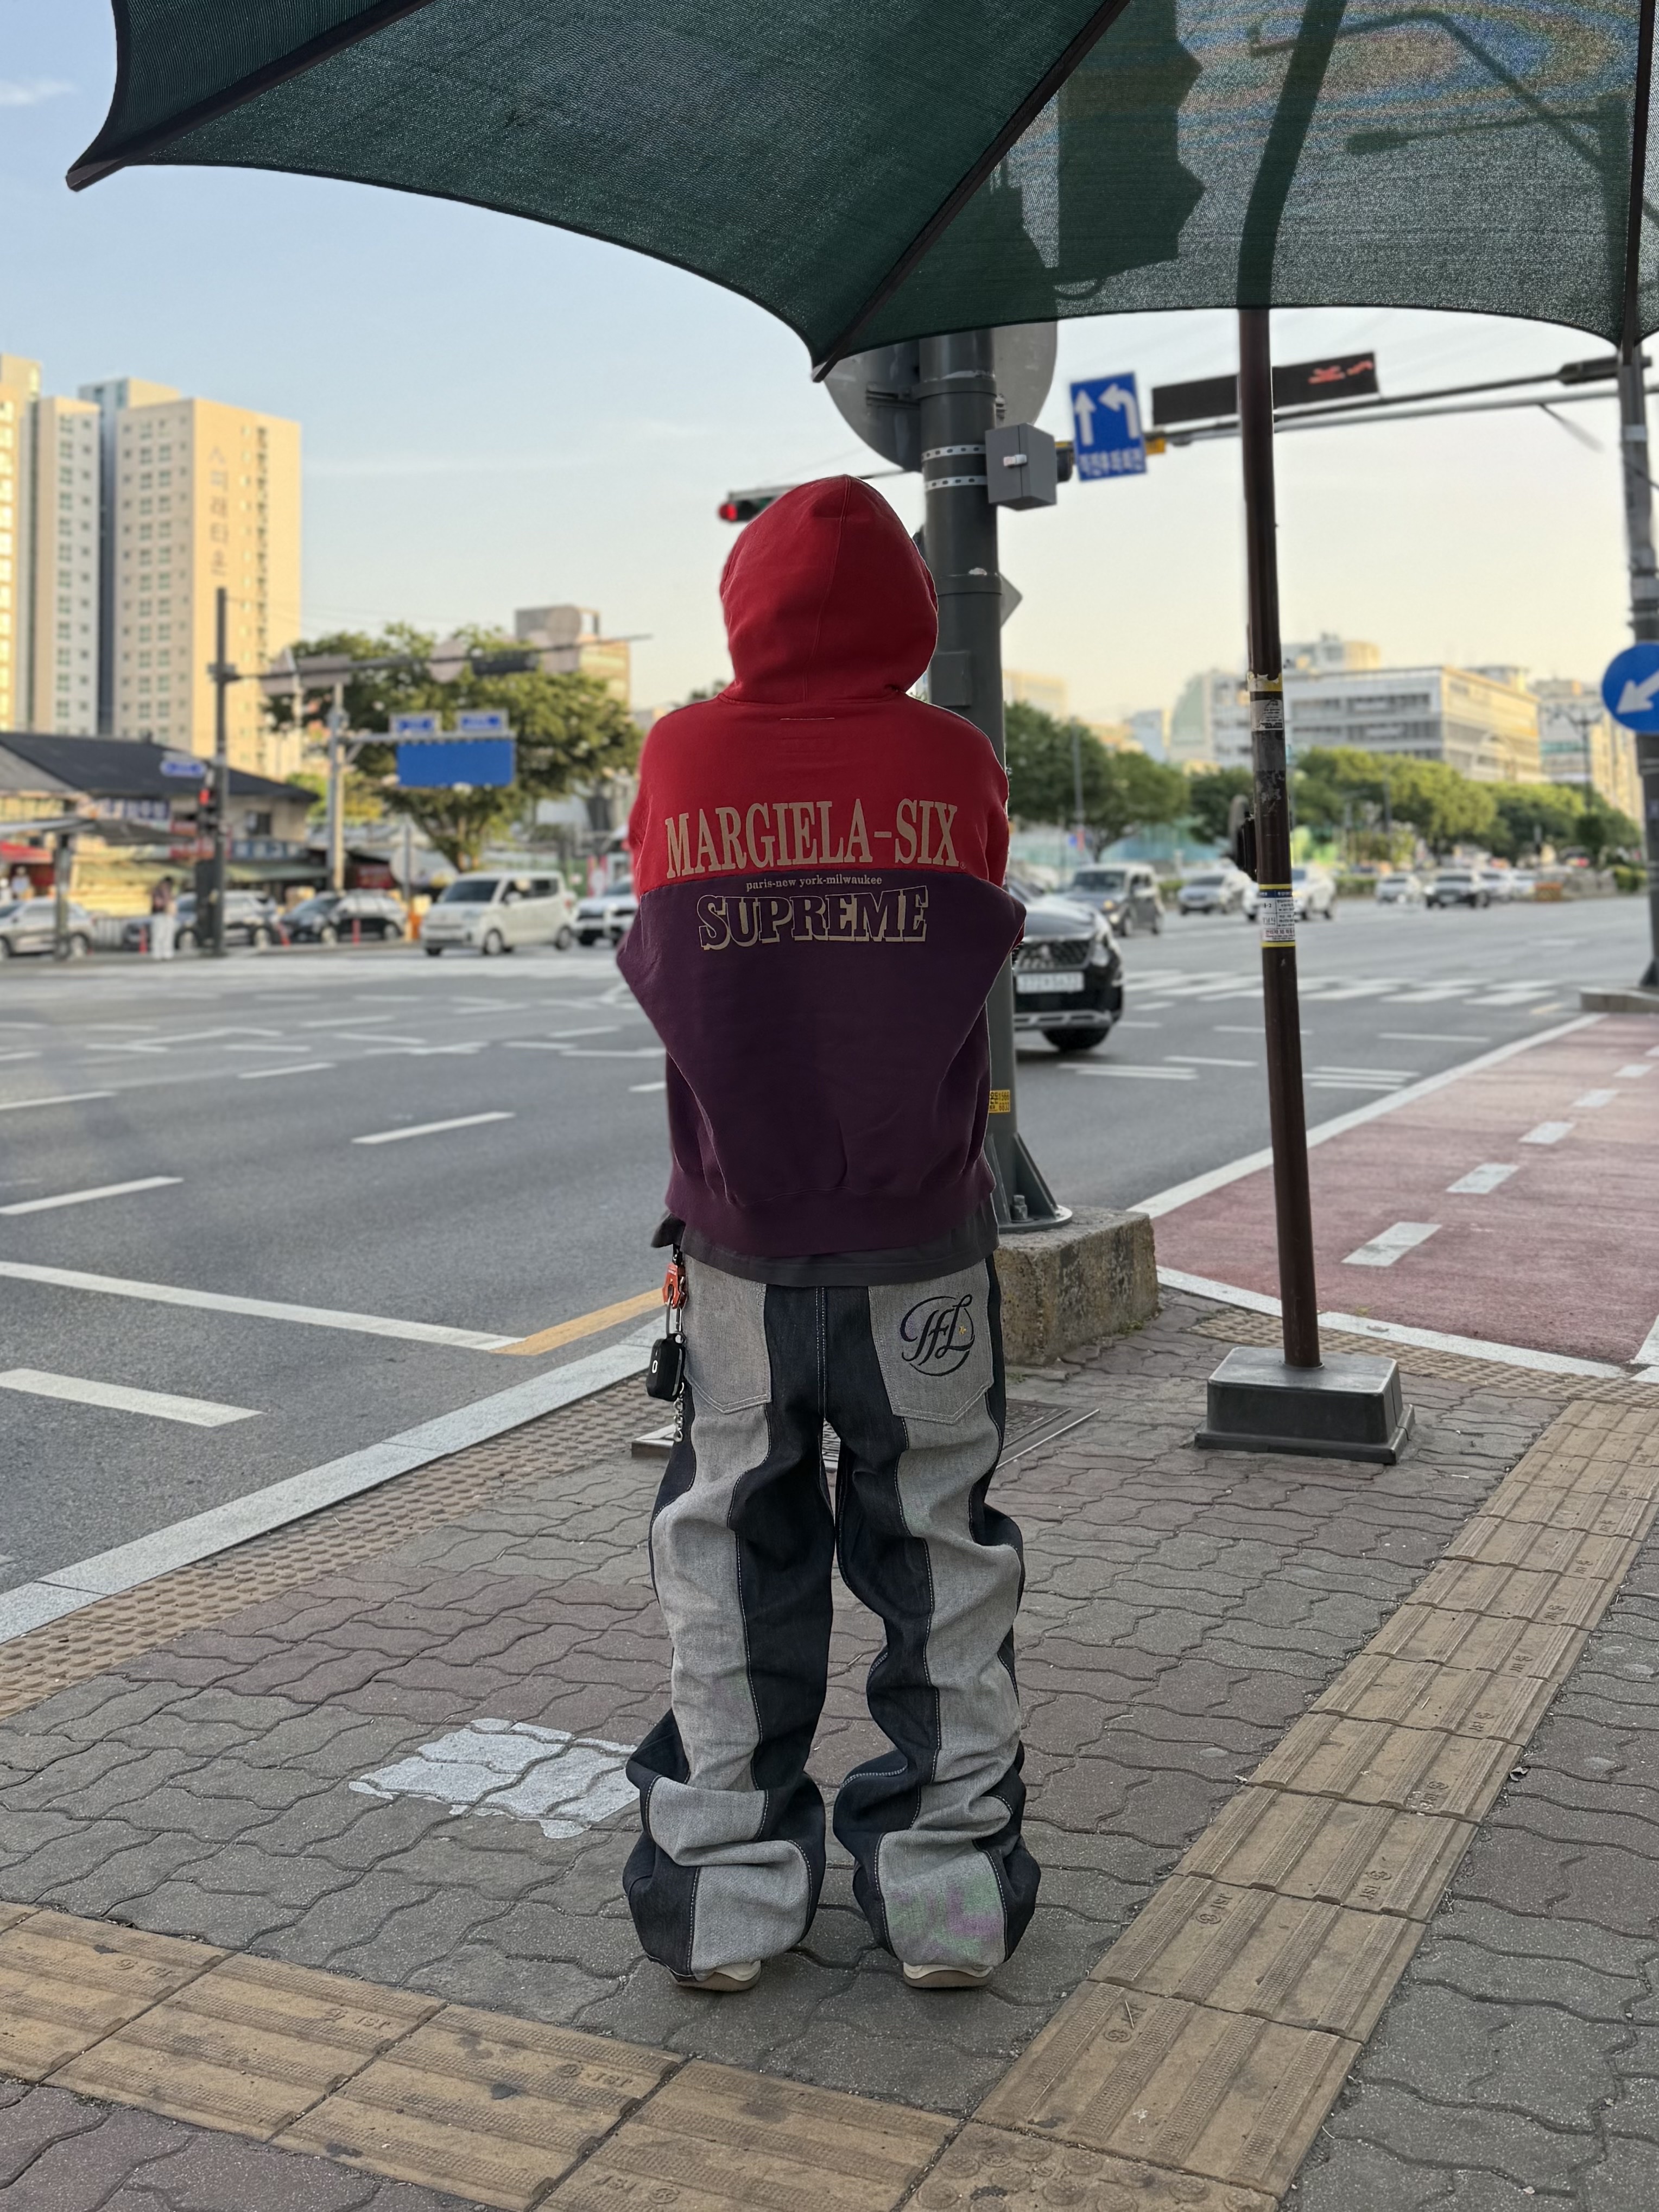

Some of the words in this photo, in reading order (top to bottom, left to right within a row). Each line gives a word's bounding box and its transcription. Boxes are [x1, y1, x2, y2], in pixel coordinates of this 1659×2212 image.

[665, 798, 960, 879] MARGIELA-SIX
[746, 878, 797, 892] paris-new
[799, 873, 883, 888] york-milwaukee
[696, 885, 929, 950] SUPREME
